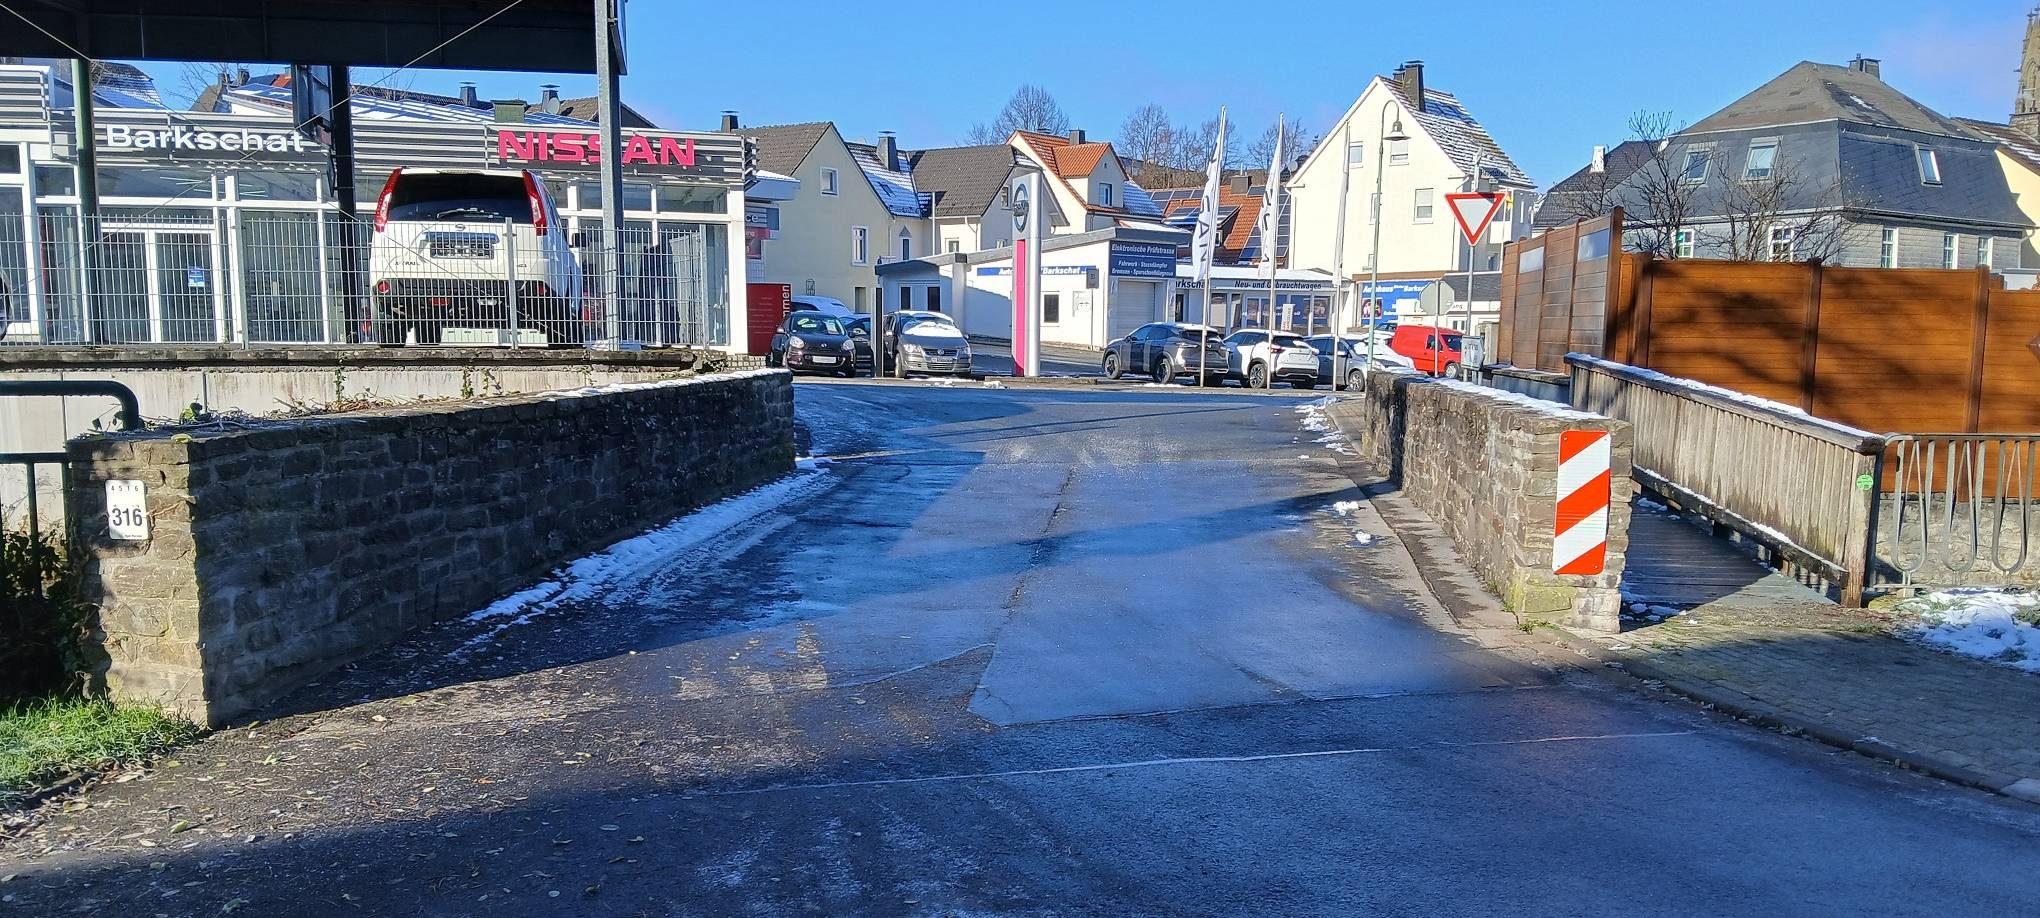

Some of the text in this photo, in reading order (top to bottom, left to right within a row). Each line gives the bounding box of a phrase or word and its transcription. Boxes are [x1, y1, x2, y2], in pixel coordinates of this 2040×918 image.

[106, 123, 304, 152] Barkschat
[1111, 243, 1146, 253] Elektronische
[1234, 280, 1251, 288] Neu-
[1266, 281, 1321, 291] Gbrauchtwagen
[111, 508, 143, 527] 316
